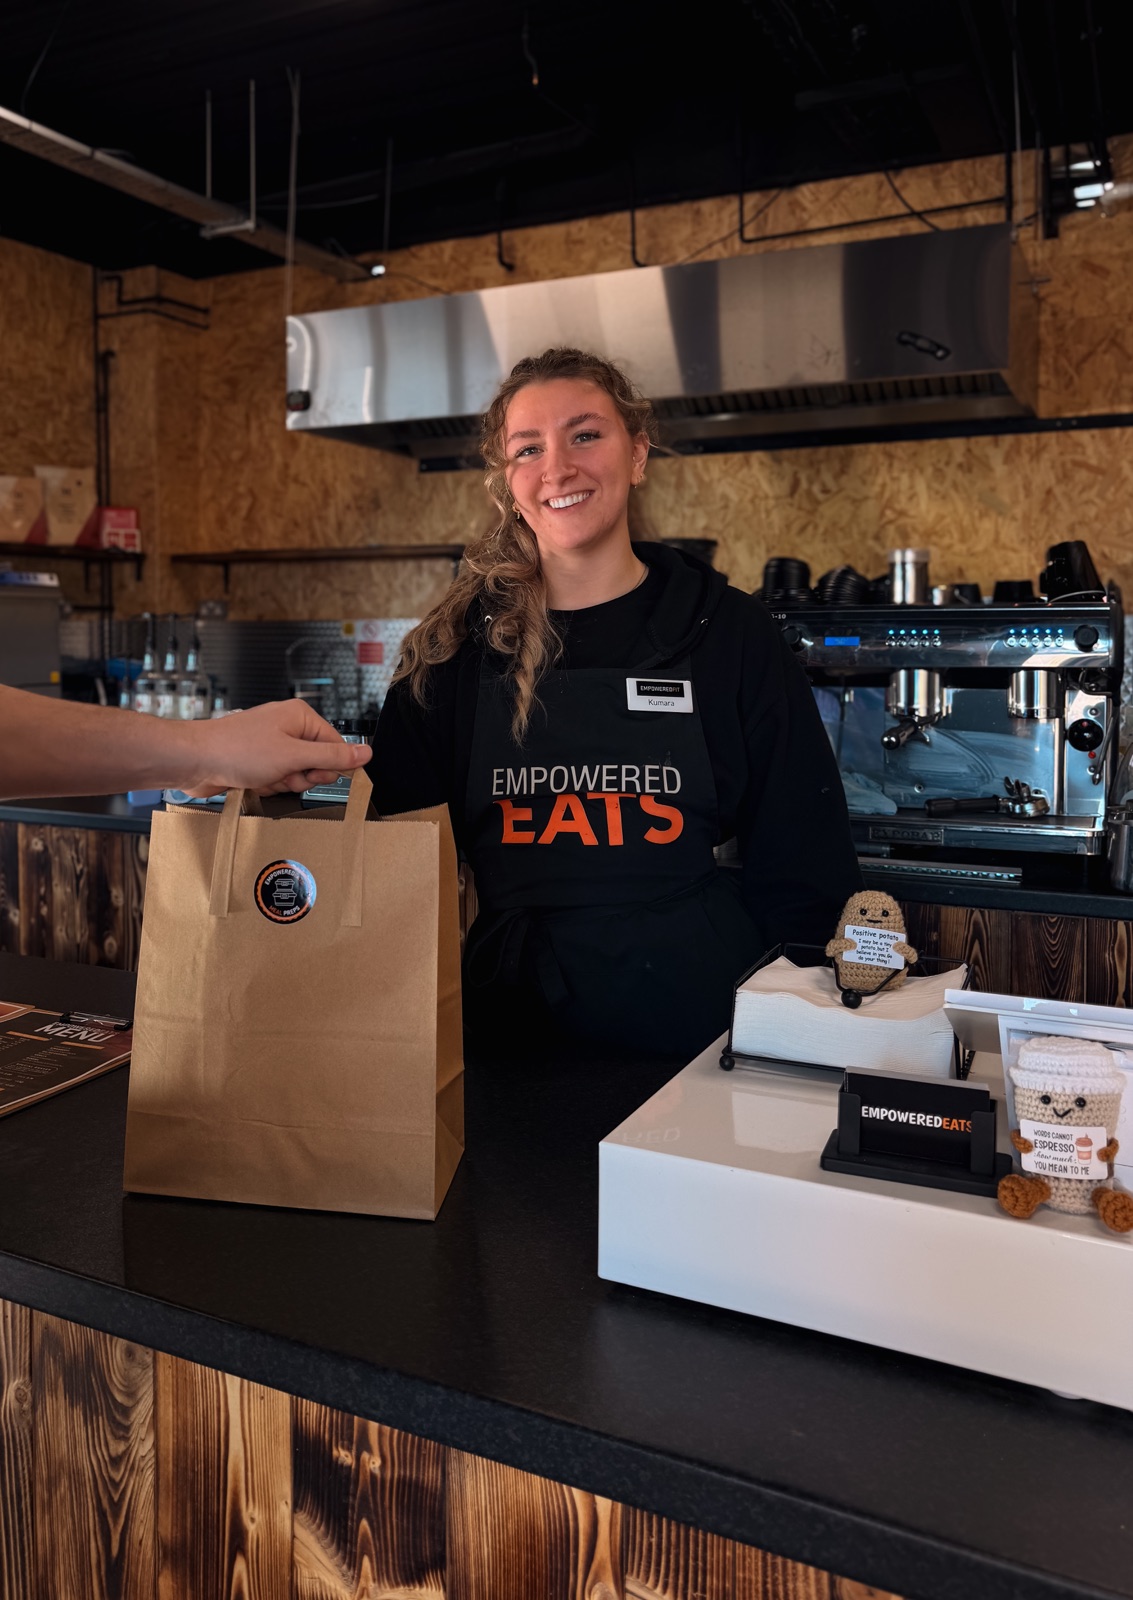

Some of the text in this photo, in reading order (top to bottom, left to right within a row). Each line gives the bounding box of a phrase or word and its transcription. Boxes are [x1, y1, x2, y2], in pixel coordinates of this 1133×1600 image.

[492, 764, 682, 796] EMPOWERED
[493, 792, 684, 846] EATS
[852, 929, 876, 937] Positive
[34, 1022, 116, 1042] MENU
[1034, 1129, 1073, 1141] WORDS CANNOT
[1034, 1139, 1075, 1153] ESPRESSO
[1034, 1161, 1090, 1175] YOU MEAN TO ME
